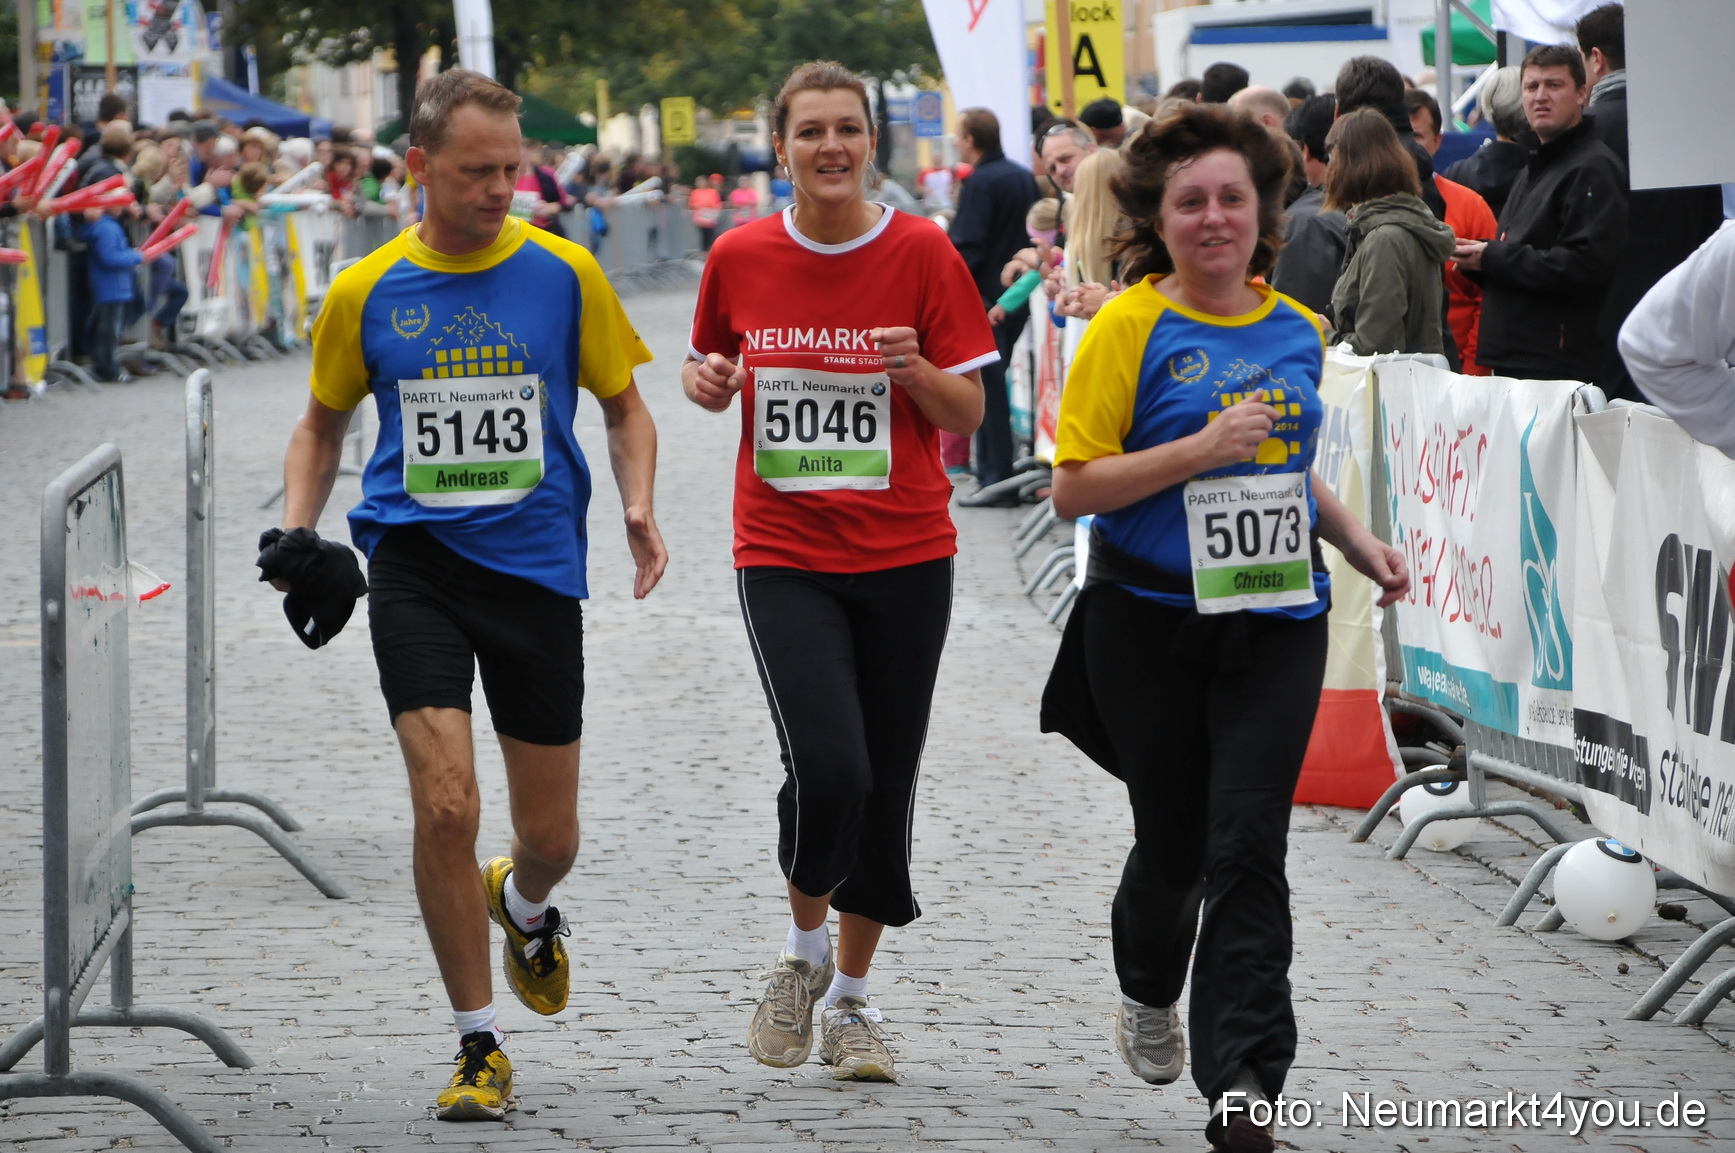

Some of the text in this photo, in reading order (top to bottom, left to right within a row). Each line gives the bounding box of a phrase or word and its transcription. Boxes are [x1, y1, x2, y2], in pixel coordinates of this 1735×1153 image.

[1070, 2, 1115, 22] lock
[1073, 32, 1107, 88] A
[405, 308, 415, 316] 15
[400, 318, 421, 327] Jahre
[823, 356, 856, 364] STARKE
[403, 389, 514, 404] PARTL Neumarkt
[757, 380, 866, 395] PARTL Neumarkt
[765, 398, 877, 444] 5046
[1274, 422, 1299, 431] 2014
[416, 406, 529, 457] 5143
[798, 455, 843, 473] Anita
[436, 468, 509, 489] Andreas
[1188, 490, 1237, 506] PARTL
[1205, 505, 1301, 560] 5073
[1234, 570, 1284, 590] Christa
